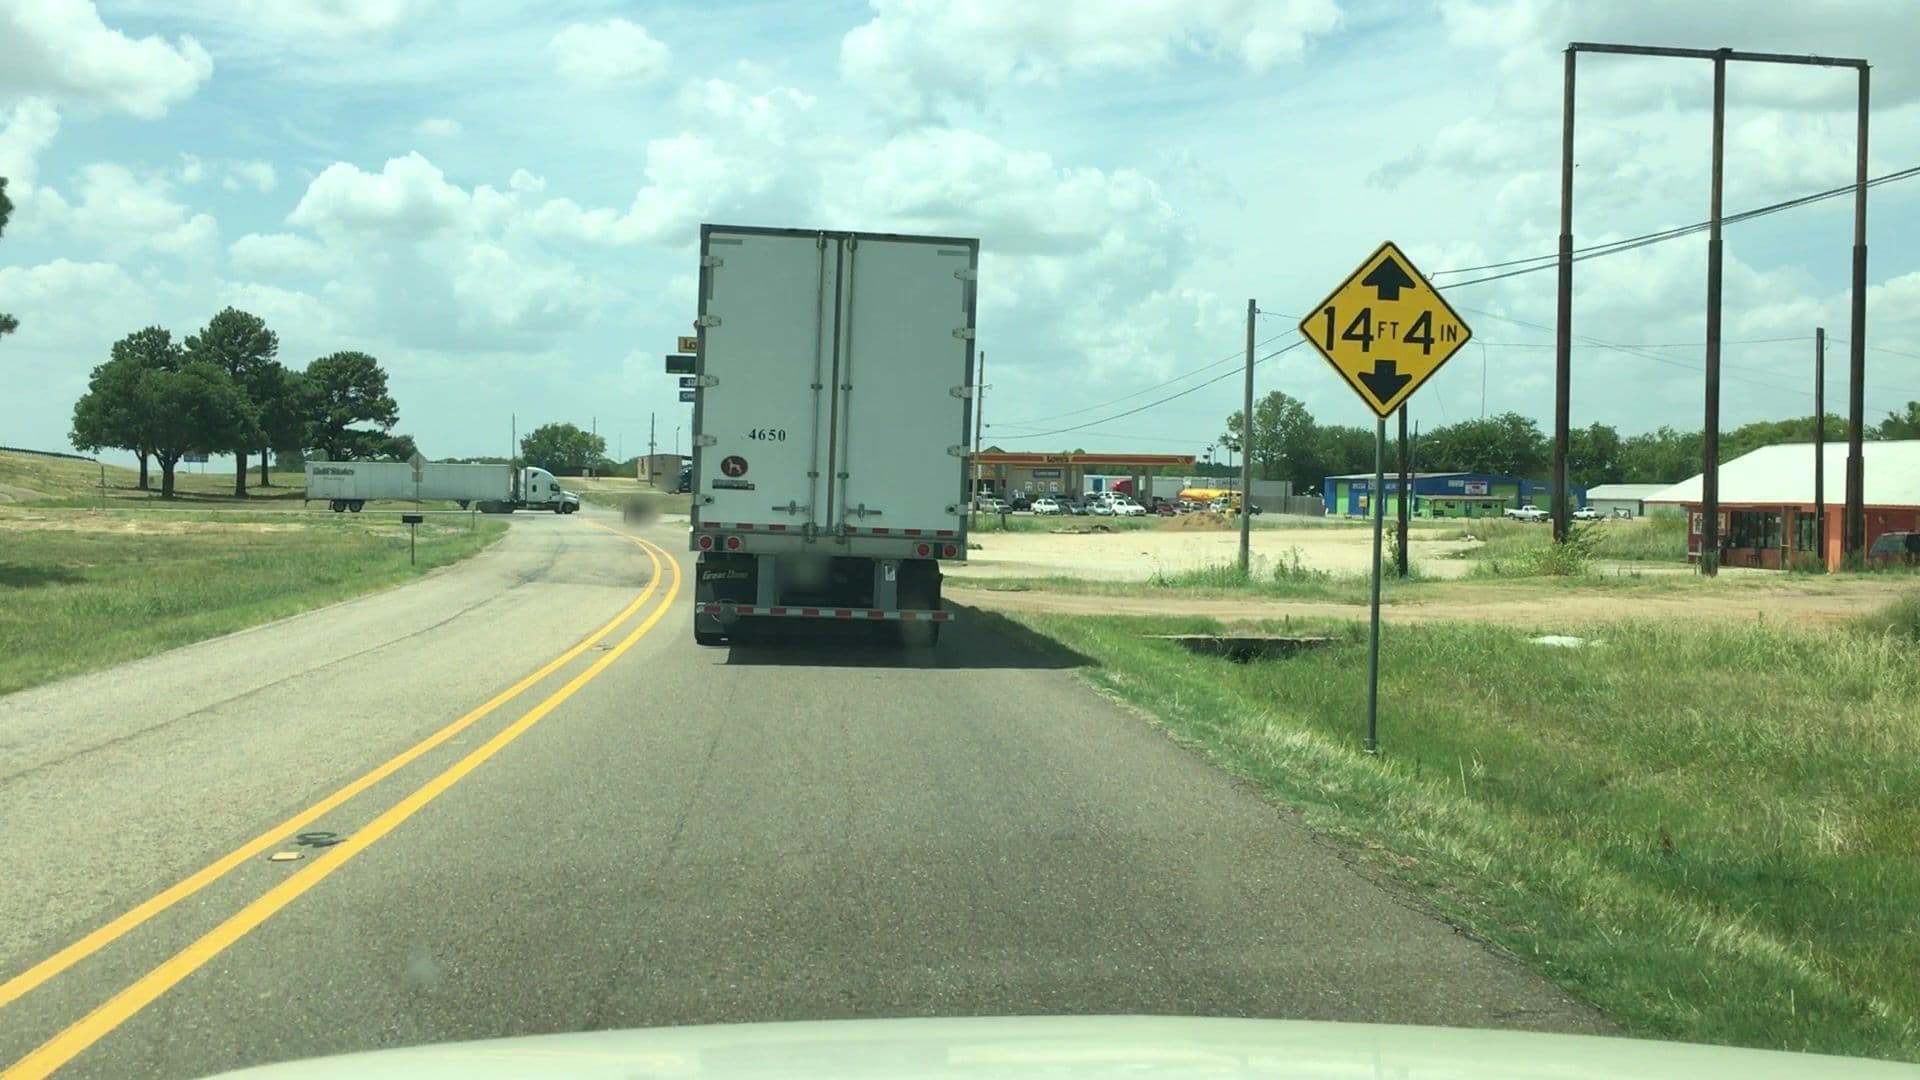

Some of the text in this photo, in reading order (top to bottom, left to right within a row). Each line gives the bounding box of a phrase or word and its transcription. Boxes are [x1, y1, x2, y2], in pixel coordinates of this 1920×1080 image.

[1324, 306, 1457, 355] 14 FT 4 IN
[748, 428, 786, 442] 4650
